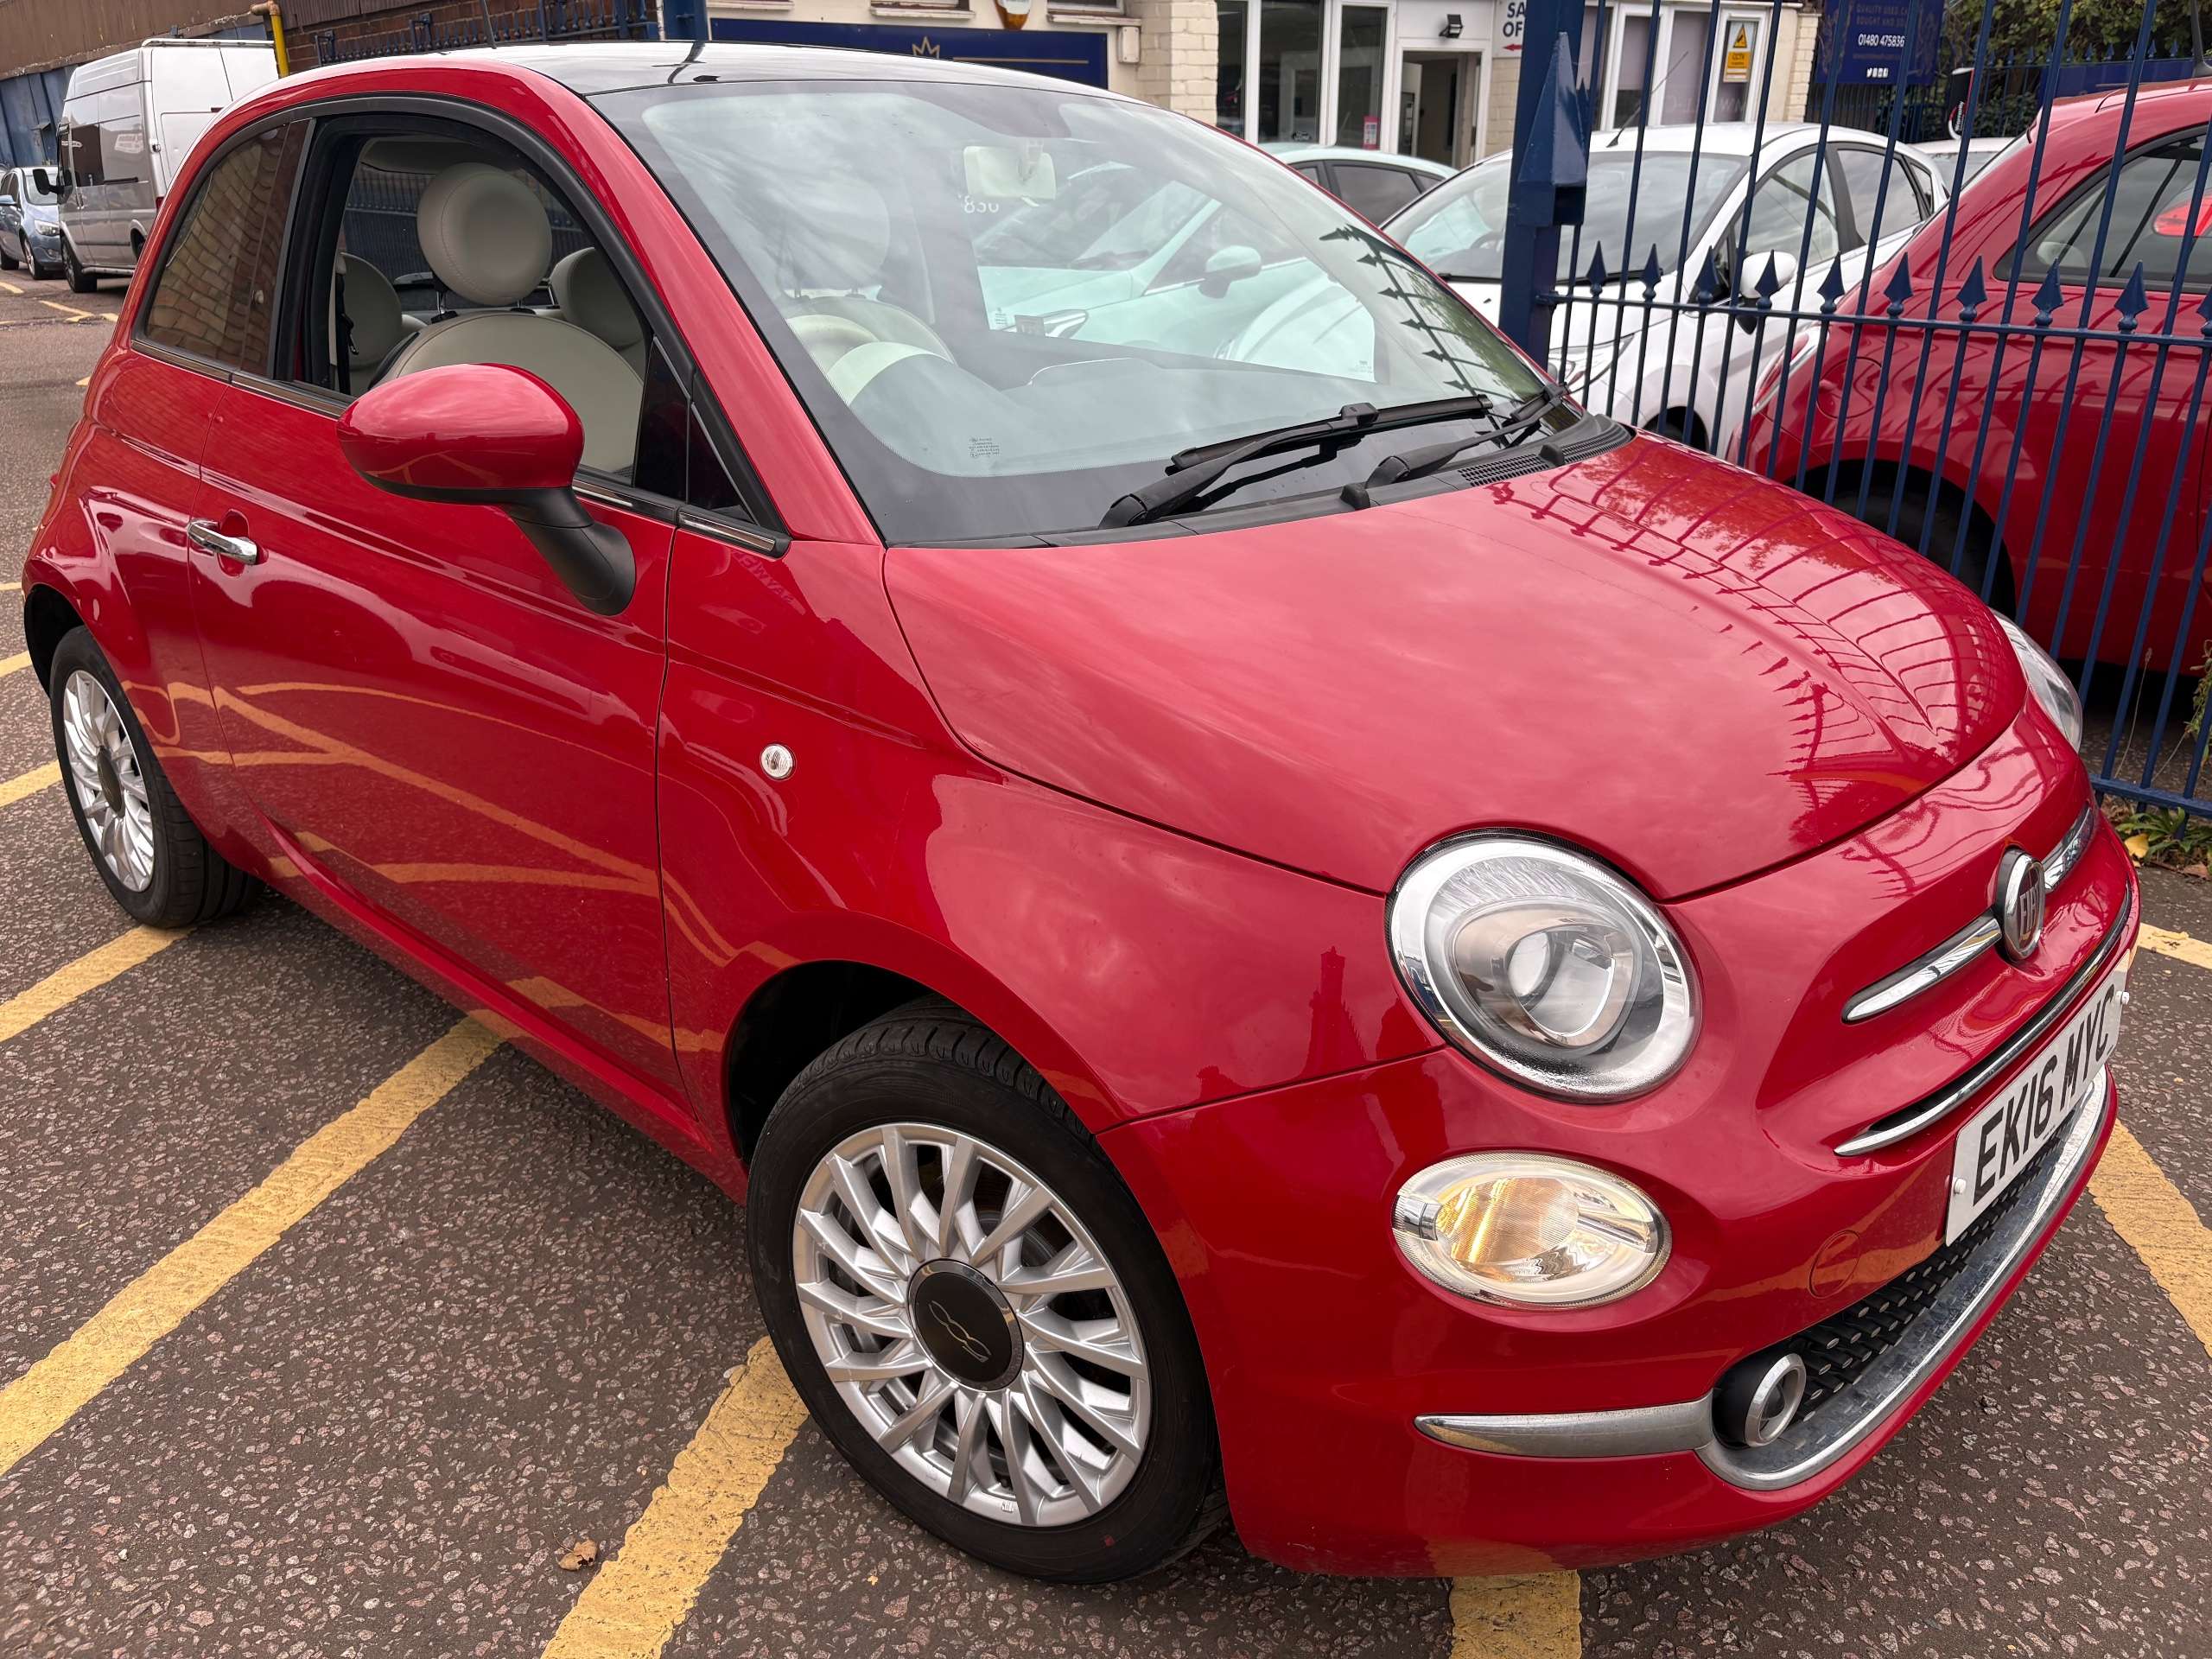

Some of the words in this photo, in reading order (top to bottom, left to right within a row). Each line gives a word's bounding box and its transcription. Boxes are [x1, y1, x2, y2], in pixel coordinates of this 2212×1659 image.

[1507, 2, 1526, 19] SA
[1503, 21, 1523, 37] OF
[1858, 33, 1879, 47] 01480
[1879, 34, 1905, 48] 475836
[1973, 1054, 2057, 1206] EK16
[2059, 983, 2114, 1112] MYC
